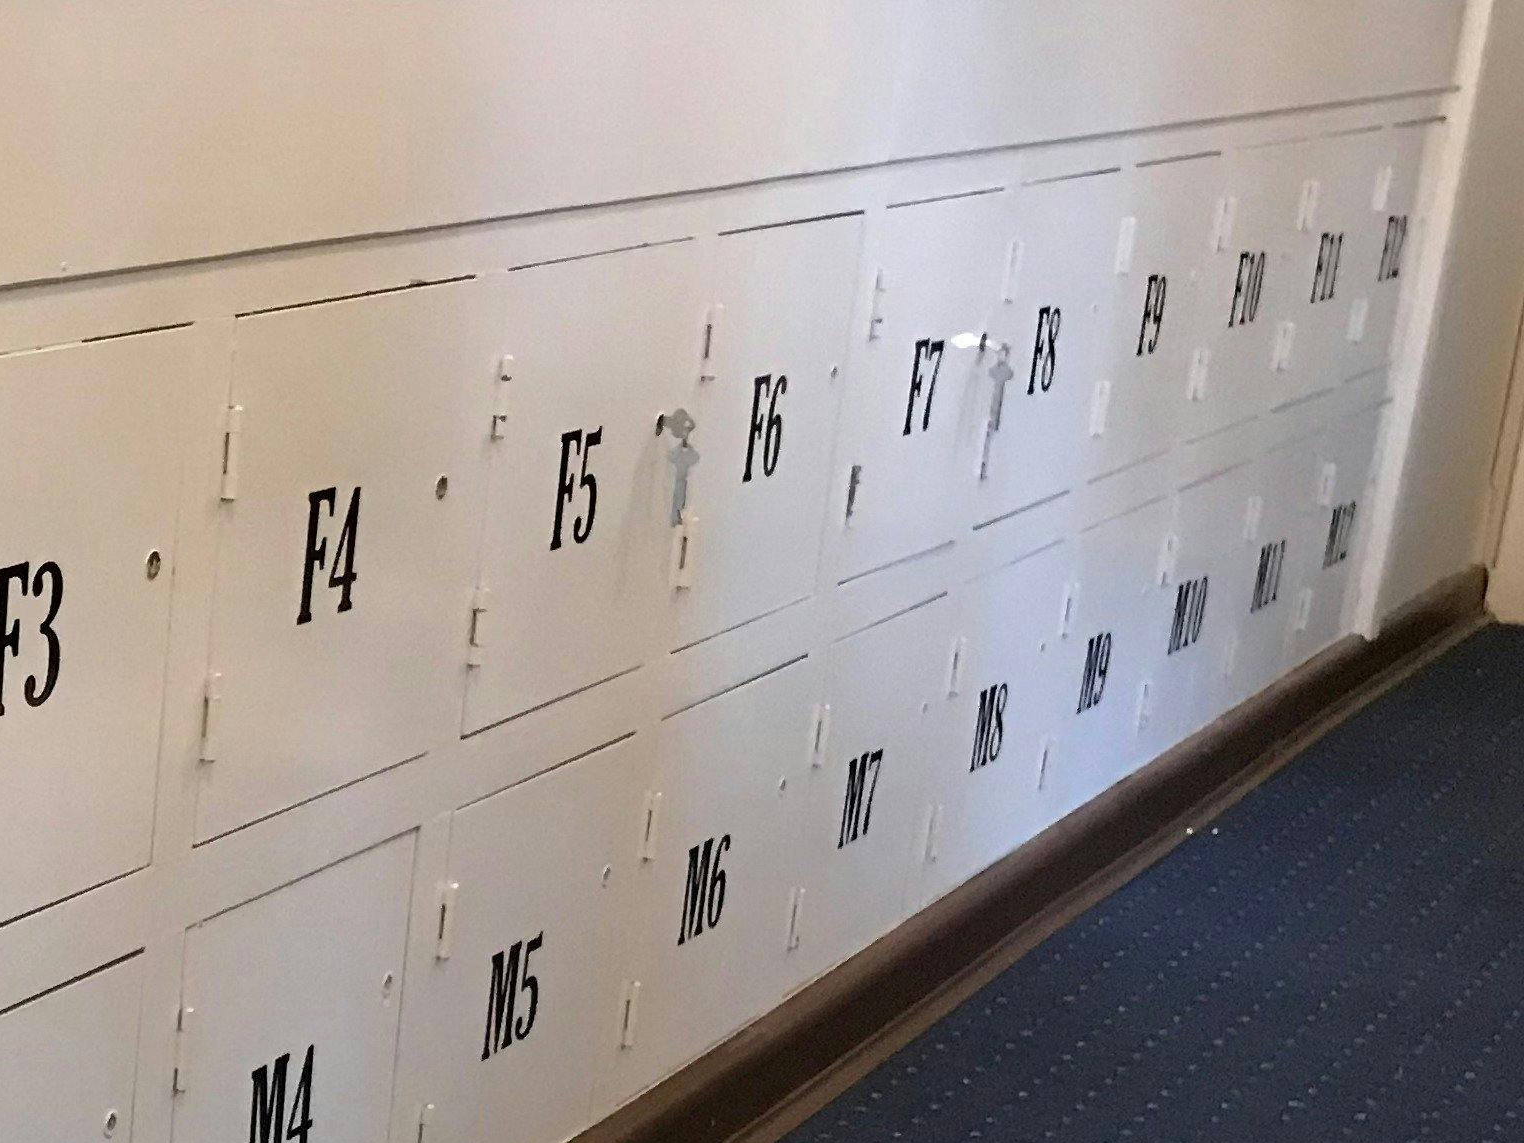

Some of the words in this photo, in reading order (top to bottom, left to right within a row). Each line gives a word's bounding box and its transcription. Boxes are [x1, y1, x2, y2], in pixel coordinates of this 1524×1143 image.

[1228, 251, 1266, 328] F10
[1310, 232, 1344, 304] F11
[1027, 306, 1060, 395] F8
[1136, 275, 1166, 357] F9
[743, 374, 787, 482] F6
[903, 338, 944, 436] F7
[550, 426, 602, 551] F5
[297, 487, 361, 625] F4
[1251, 540, 1285, 614] M11
[1168, 576, 1208, 655] M10
[1076, 633, 1111, 714] M9
[970, 683, 1007, 772] M8
[838, 749, 883, 849] M7
[678, 835, 730, 946] M6
[481, 931, 543, 1061] M5
